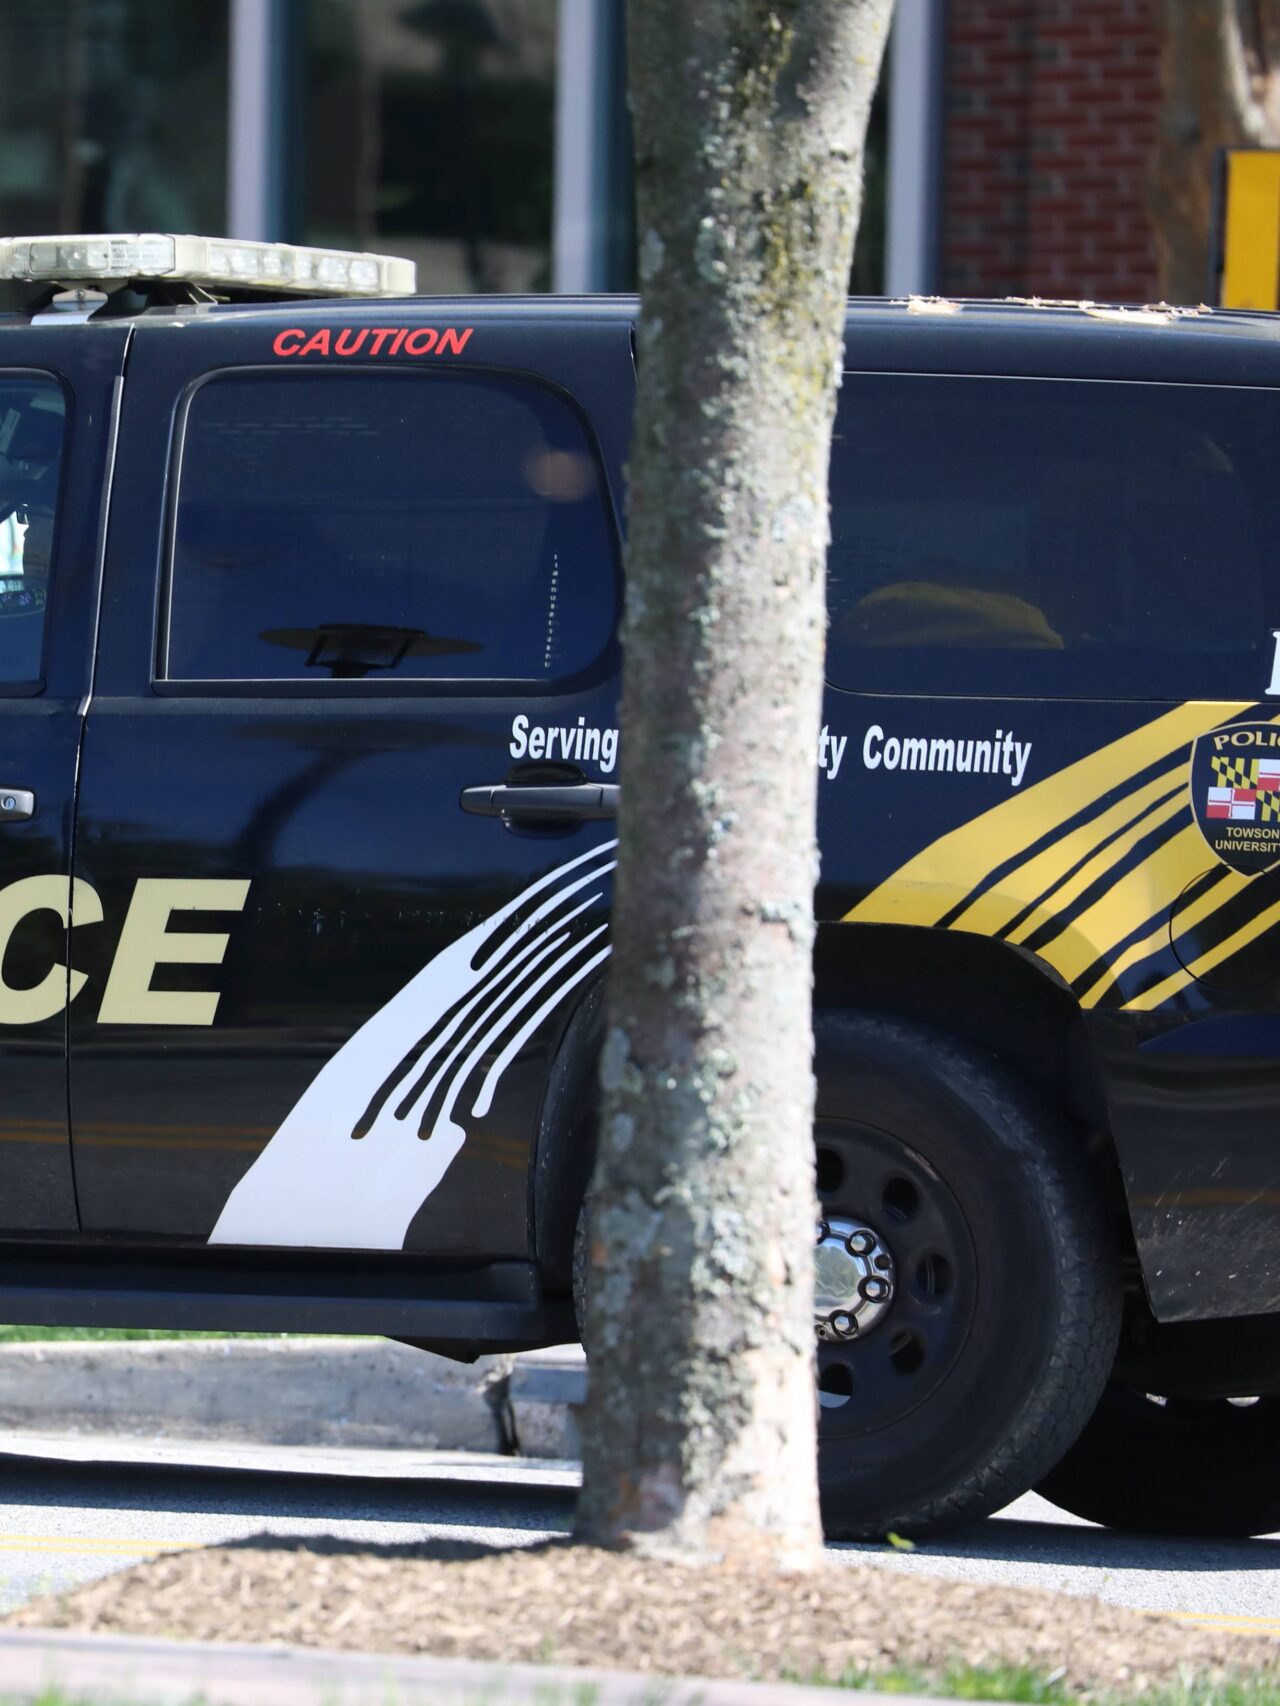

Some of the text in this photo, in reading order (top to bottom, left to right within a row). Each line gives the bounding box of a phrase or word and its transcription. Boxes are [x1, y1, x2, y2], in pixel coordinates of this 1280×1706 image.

[272, 327, 474, 357] CAUTION
[509, 714, 619, 773] Serving
[862, 724, 1033, 787] Community
[1226, 827, 1280, 840] TOWSON
[1215, 839, 1280, 853] UNIVERSIT
